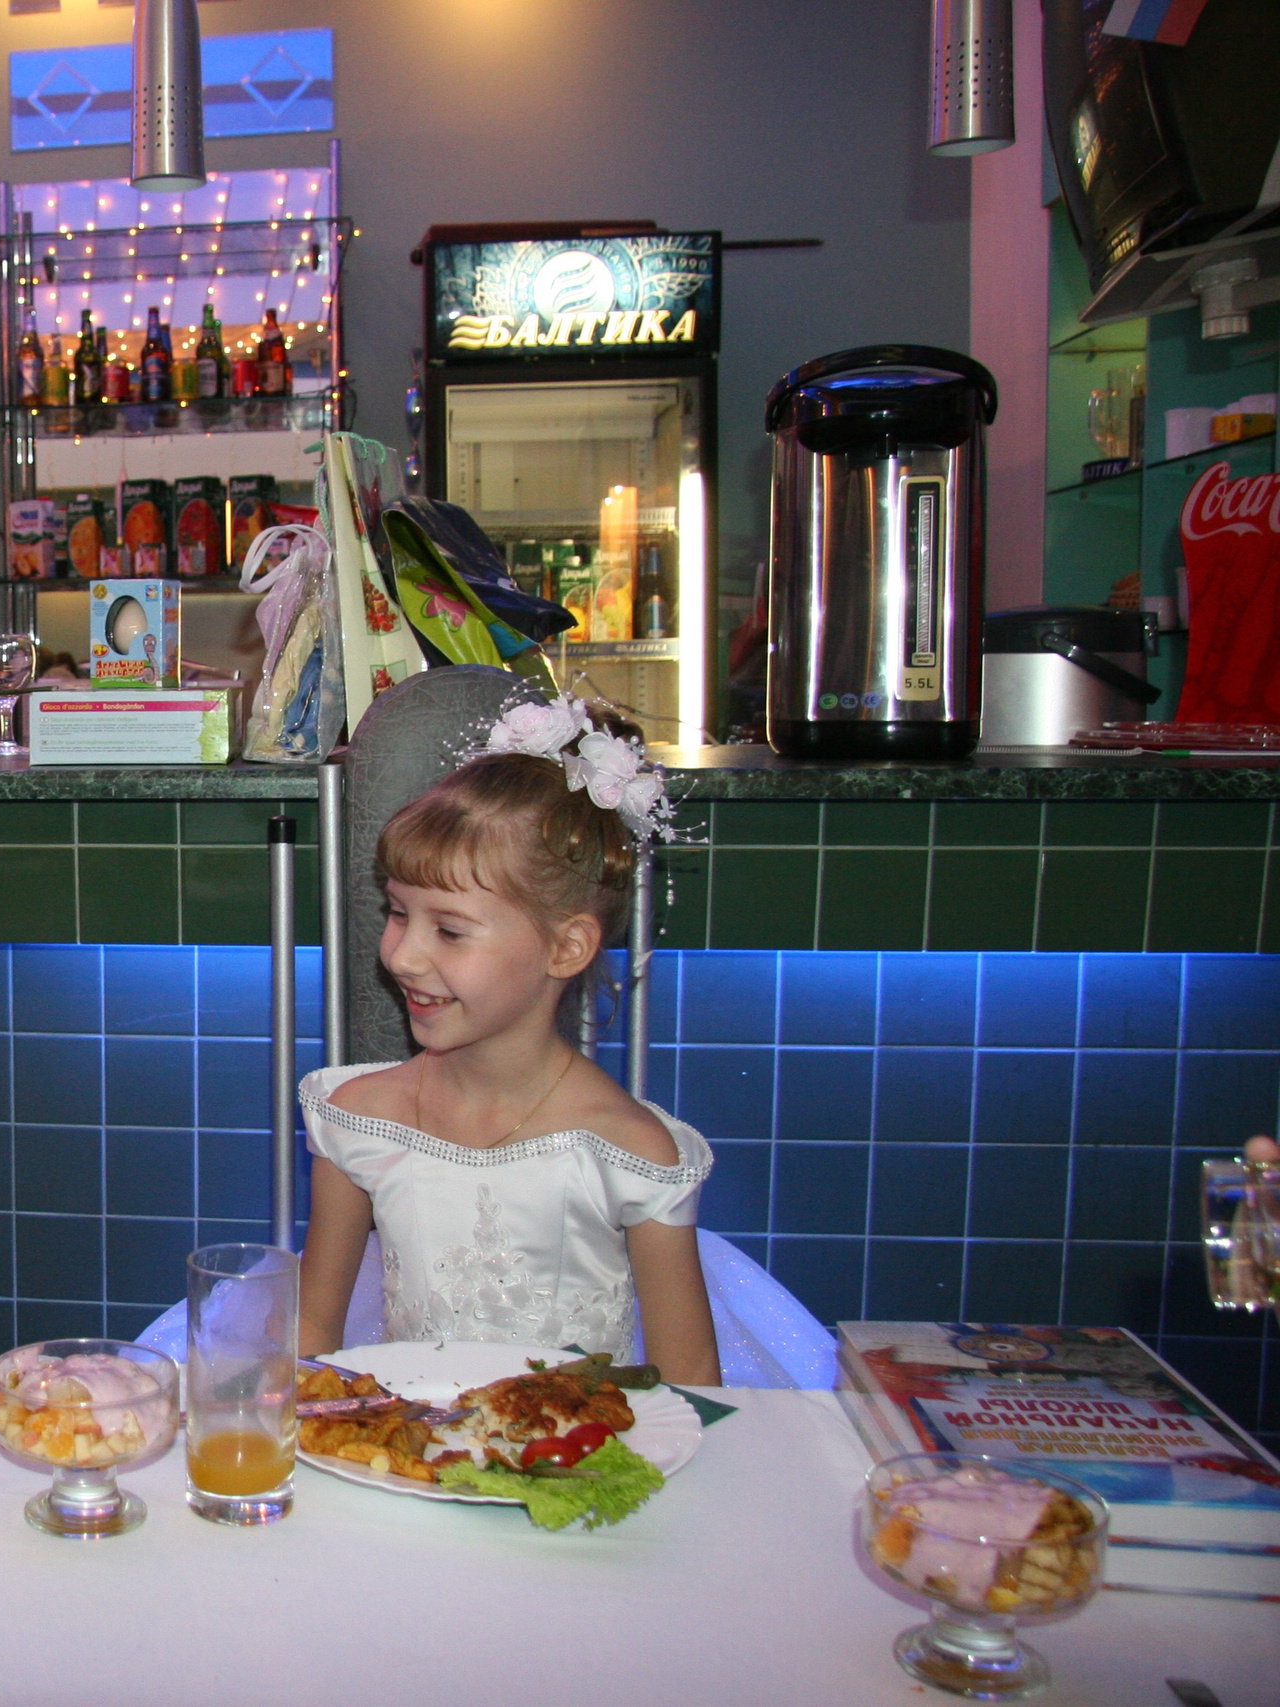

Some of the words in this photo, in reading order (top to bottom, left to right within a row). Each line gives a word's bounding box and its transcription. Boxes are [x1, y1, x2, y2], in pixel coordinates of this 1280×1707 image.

[671, 256, 708, 269] 1990
[482, 309, 698, 348] БАЛТИКА
[904, 678, 934, 689] 5.5L
[42, 703, 61, 711] Gioco
[976, 1398, 1133, 1415] ШКОЛЫ
[943, 1411, 1195, 1431] НАЧАЛЬНОЙ
[957, 1428, 1210, 1447] ЭНЦИКЛОПЕДИЯ
[1013, 1440, 1171, 1457] БОЛЬШАЯ
